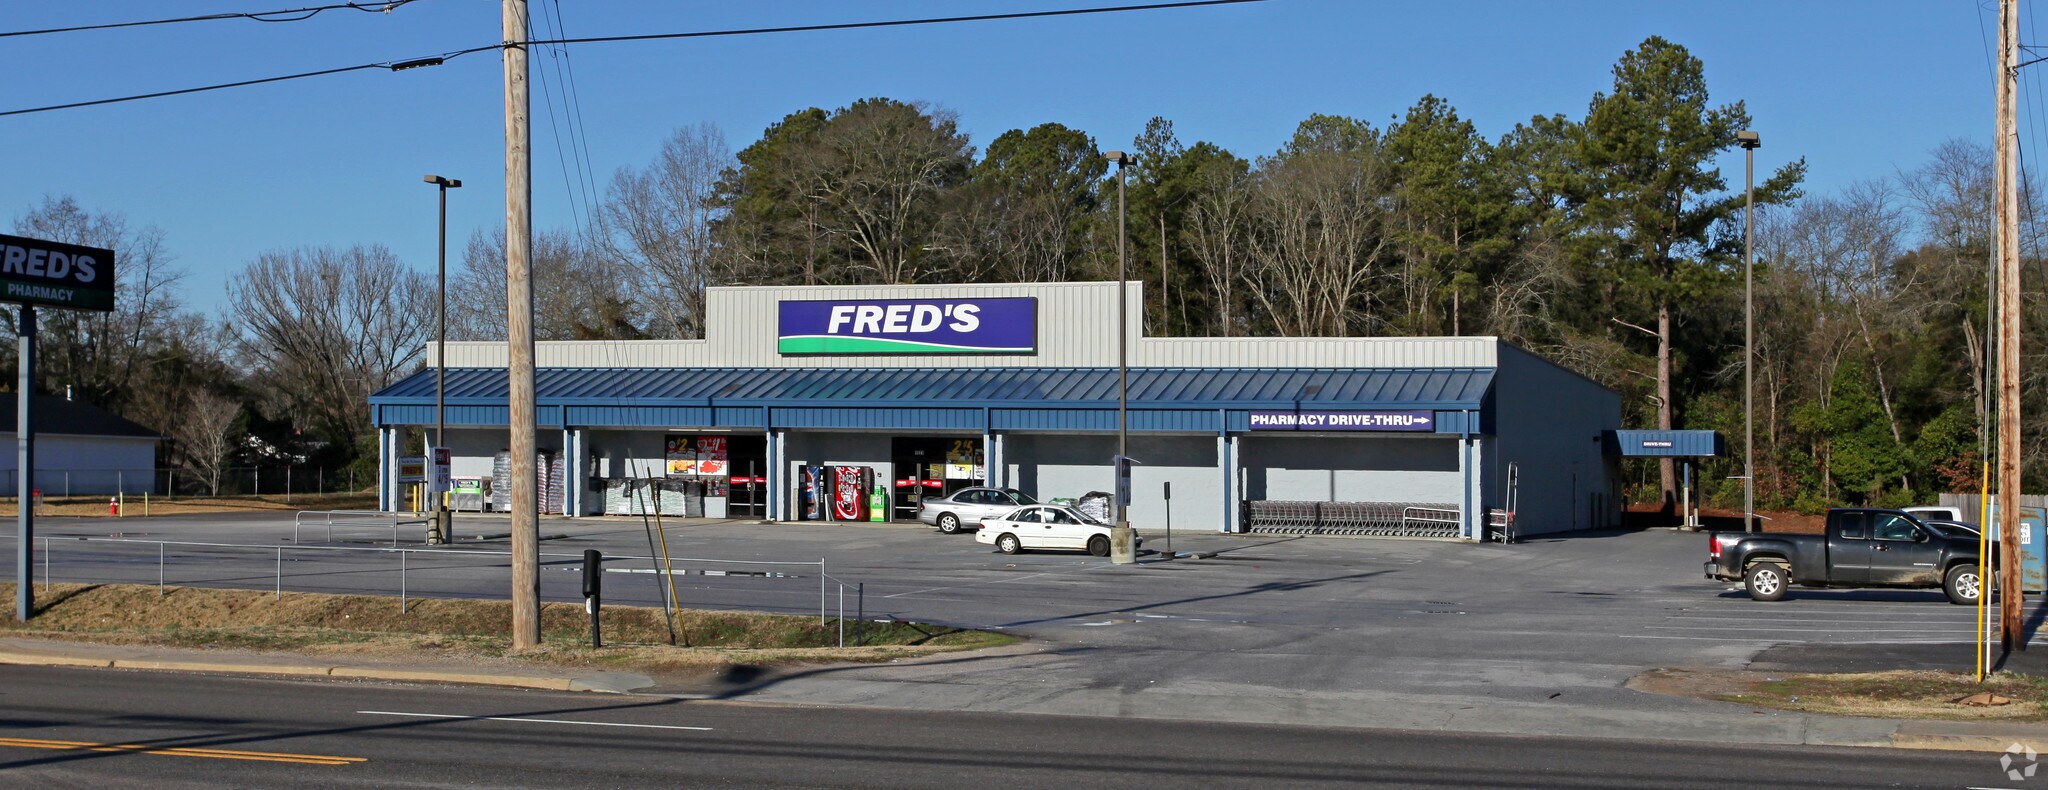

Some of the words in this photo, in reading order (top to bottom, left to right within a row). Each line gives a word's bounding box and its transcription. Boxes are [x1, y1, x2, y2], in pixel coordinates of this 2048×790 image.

[0, 244, 96, 283] RED'S
[8, 283, 74, 301] PHARMACY
[827, 303, 981, 334] FRED'S
[1250, 414, 1326, 426] PHARMACY
[1328, 415, 1413, 426] DRIVE-THRU
